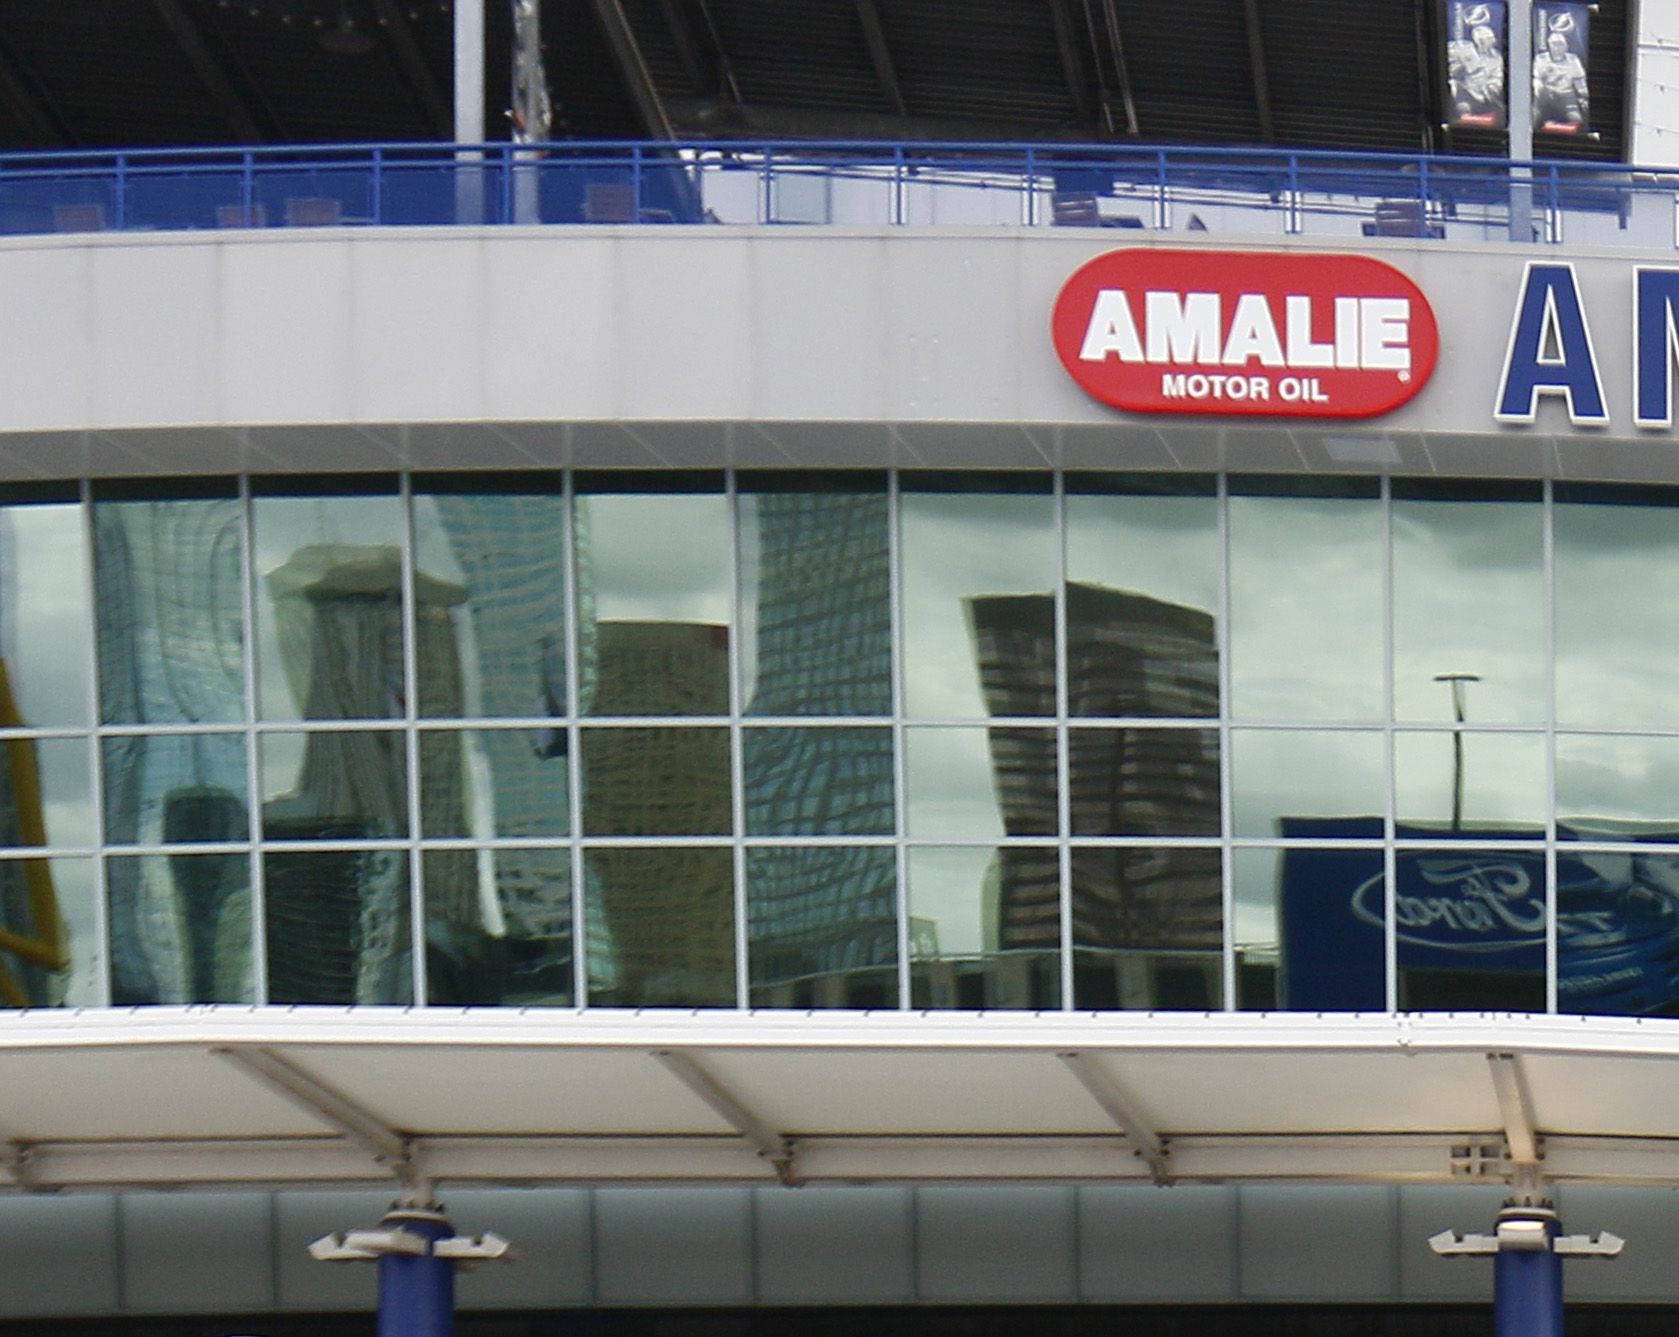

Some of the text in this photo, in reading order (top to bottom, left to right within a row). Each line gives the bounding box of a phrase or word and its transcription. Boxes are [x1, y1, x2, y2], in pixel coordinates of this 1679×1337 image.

[1080, 289, 1412, 371] AMALIE
[1161, 372, 1329, 404] MOTOR OIL
